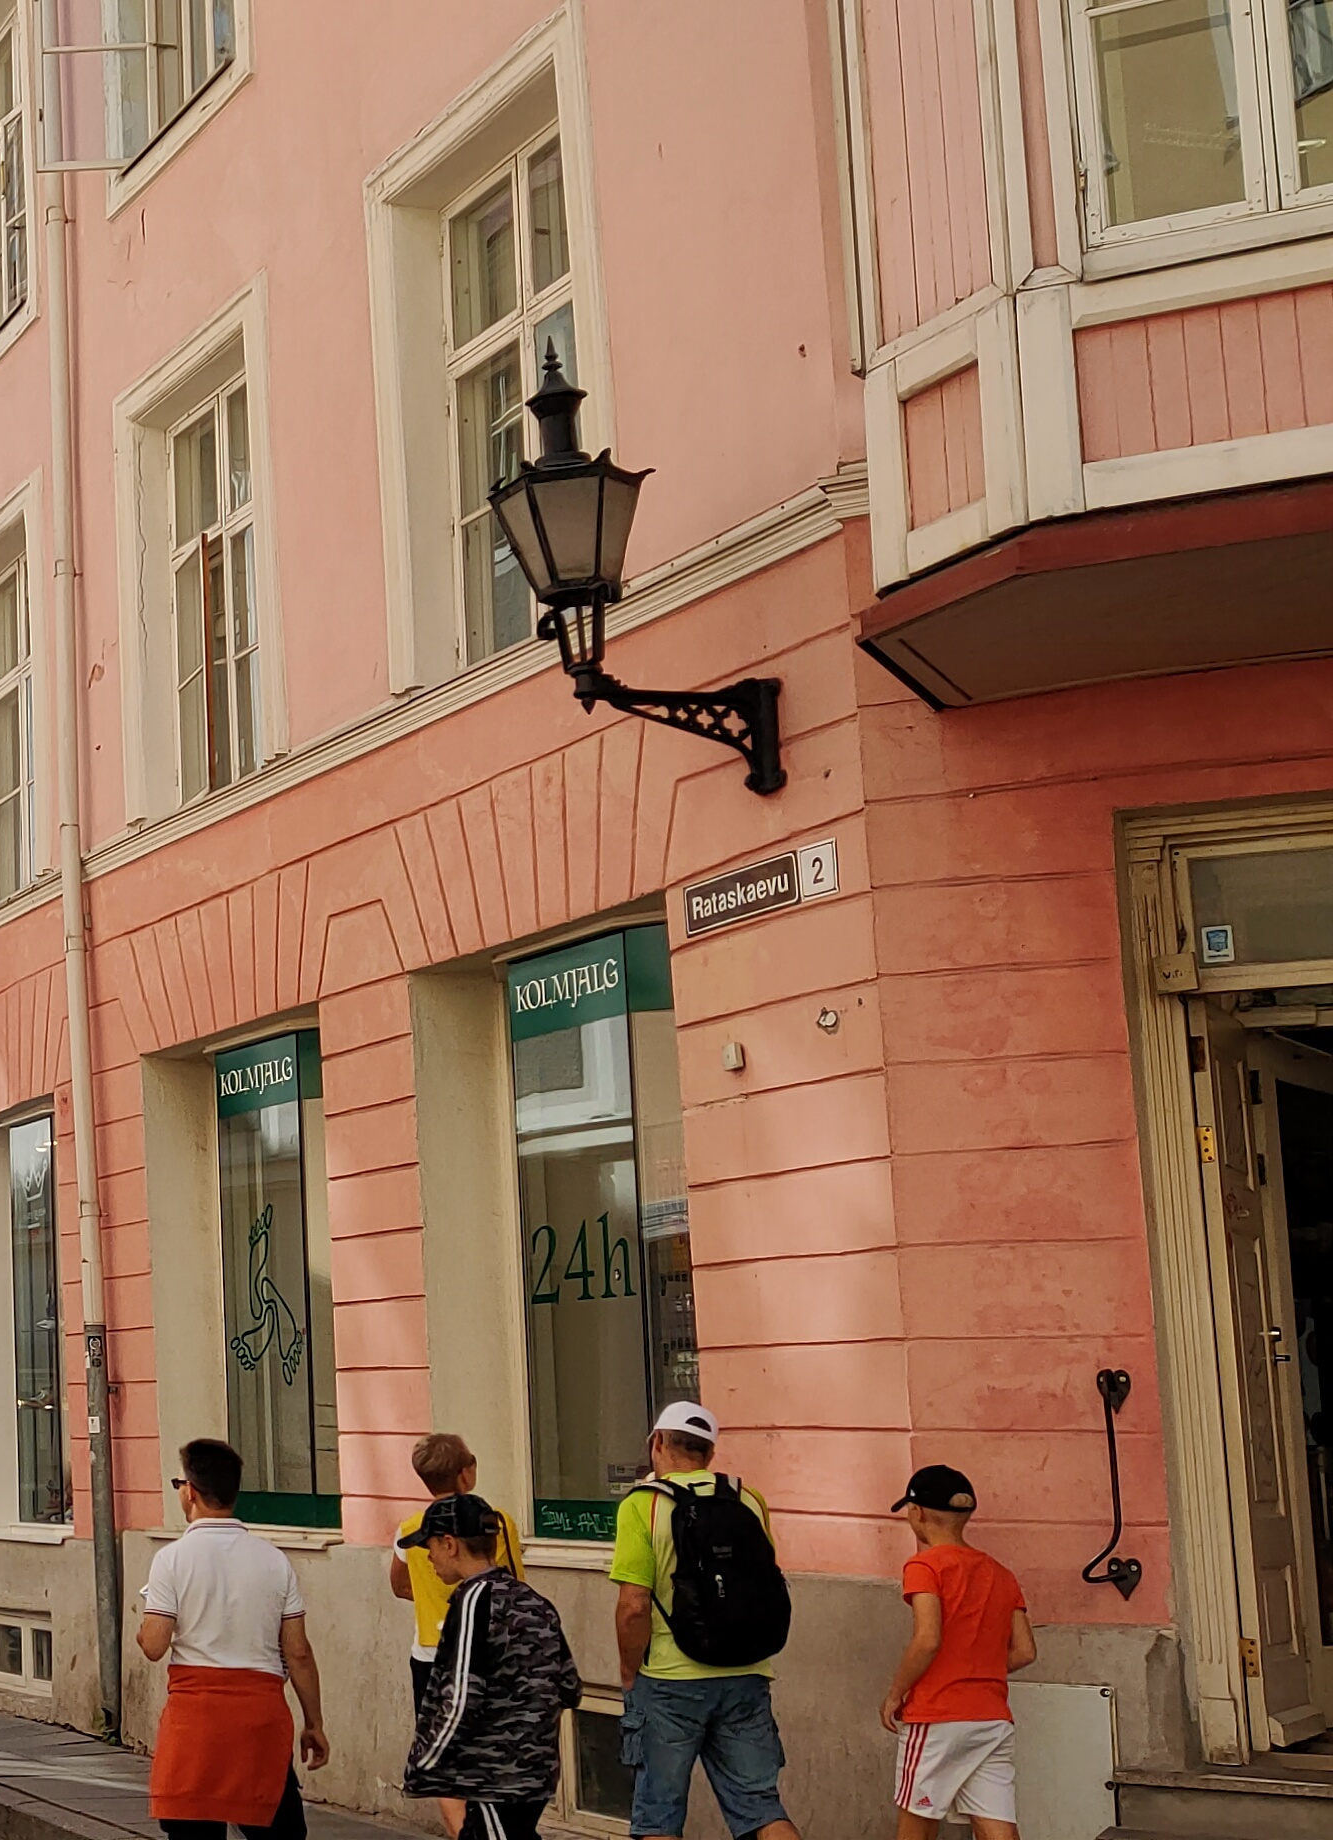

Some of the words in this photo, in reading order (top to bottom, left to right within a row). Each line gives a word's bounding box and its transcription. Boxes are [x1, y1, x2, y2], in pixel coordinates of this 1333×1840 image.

[691, 873, 789, 920] Rataskaevu
[811, 856, 825, 885] 2
[515, 958, 619, 1013] KOLMJALG
[219, 1056, 293, 1097] KOLMJALG
[531, 1211, 637, 1304] 24h
